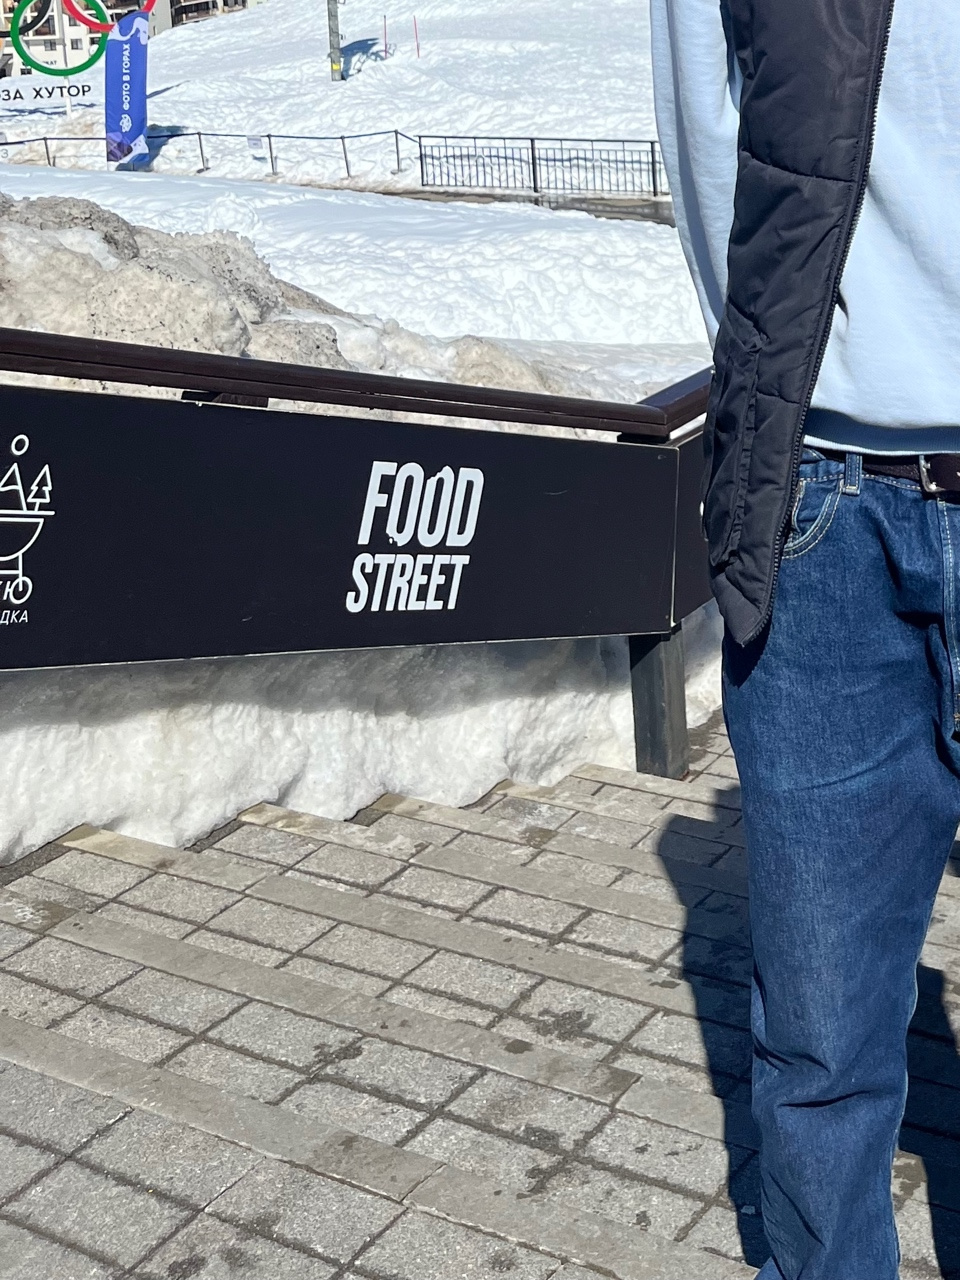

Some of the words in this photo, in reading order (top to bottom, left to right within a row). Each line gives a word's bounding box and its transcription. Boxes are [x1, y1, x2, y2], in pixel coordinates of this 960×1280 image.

[122, 43, 130, 73] ГОРАХ
[0, 88, 24, 101] ЗА
[33, 84, 91, 99] ХУТОР
[122, 82, 130, 110] ФОТО
[357, 460, 485, 547] FOOD
[345, 552, 471, 613] STREET
